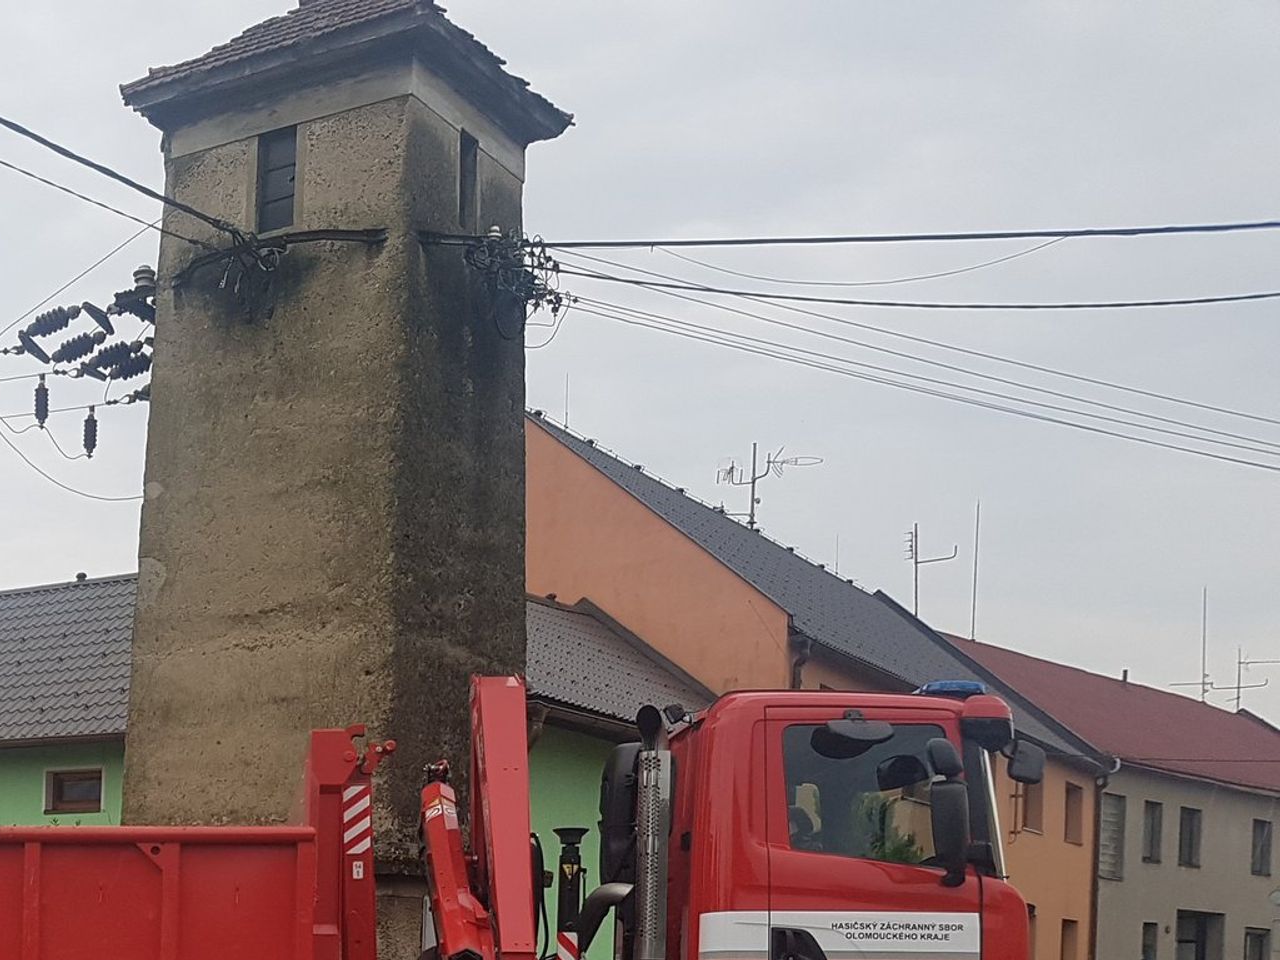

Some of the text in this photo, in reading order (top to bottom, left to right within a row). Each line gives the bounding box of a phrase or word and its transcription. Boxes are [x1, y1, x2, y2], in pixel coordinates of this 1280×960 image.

[831, 921, 964, 932] HASIČSKÝ ZÁCHRANNÝ SBOR
[845, 932, 951, 941] OLOMOUCKÉHO KRAJE
